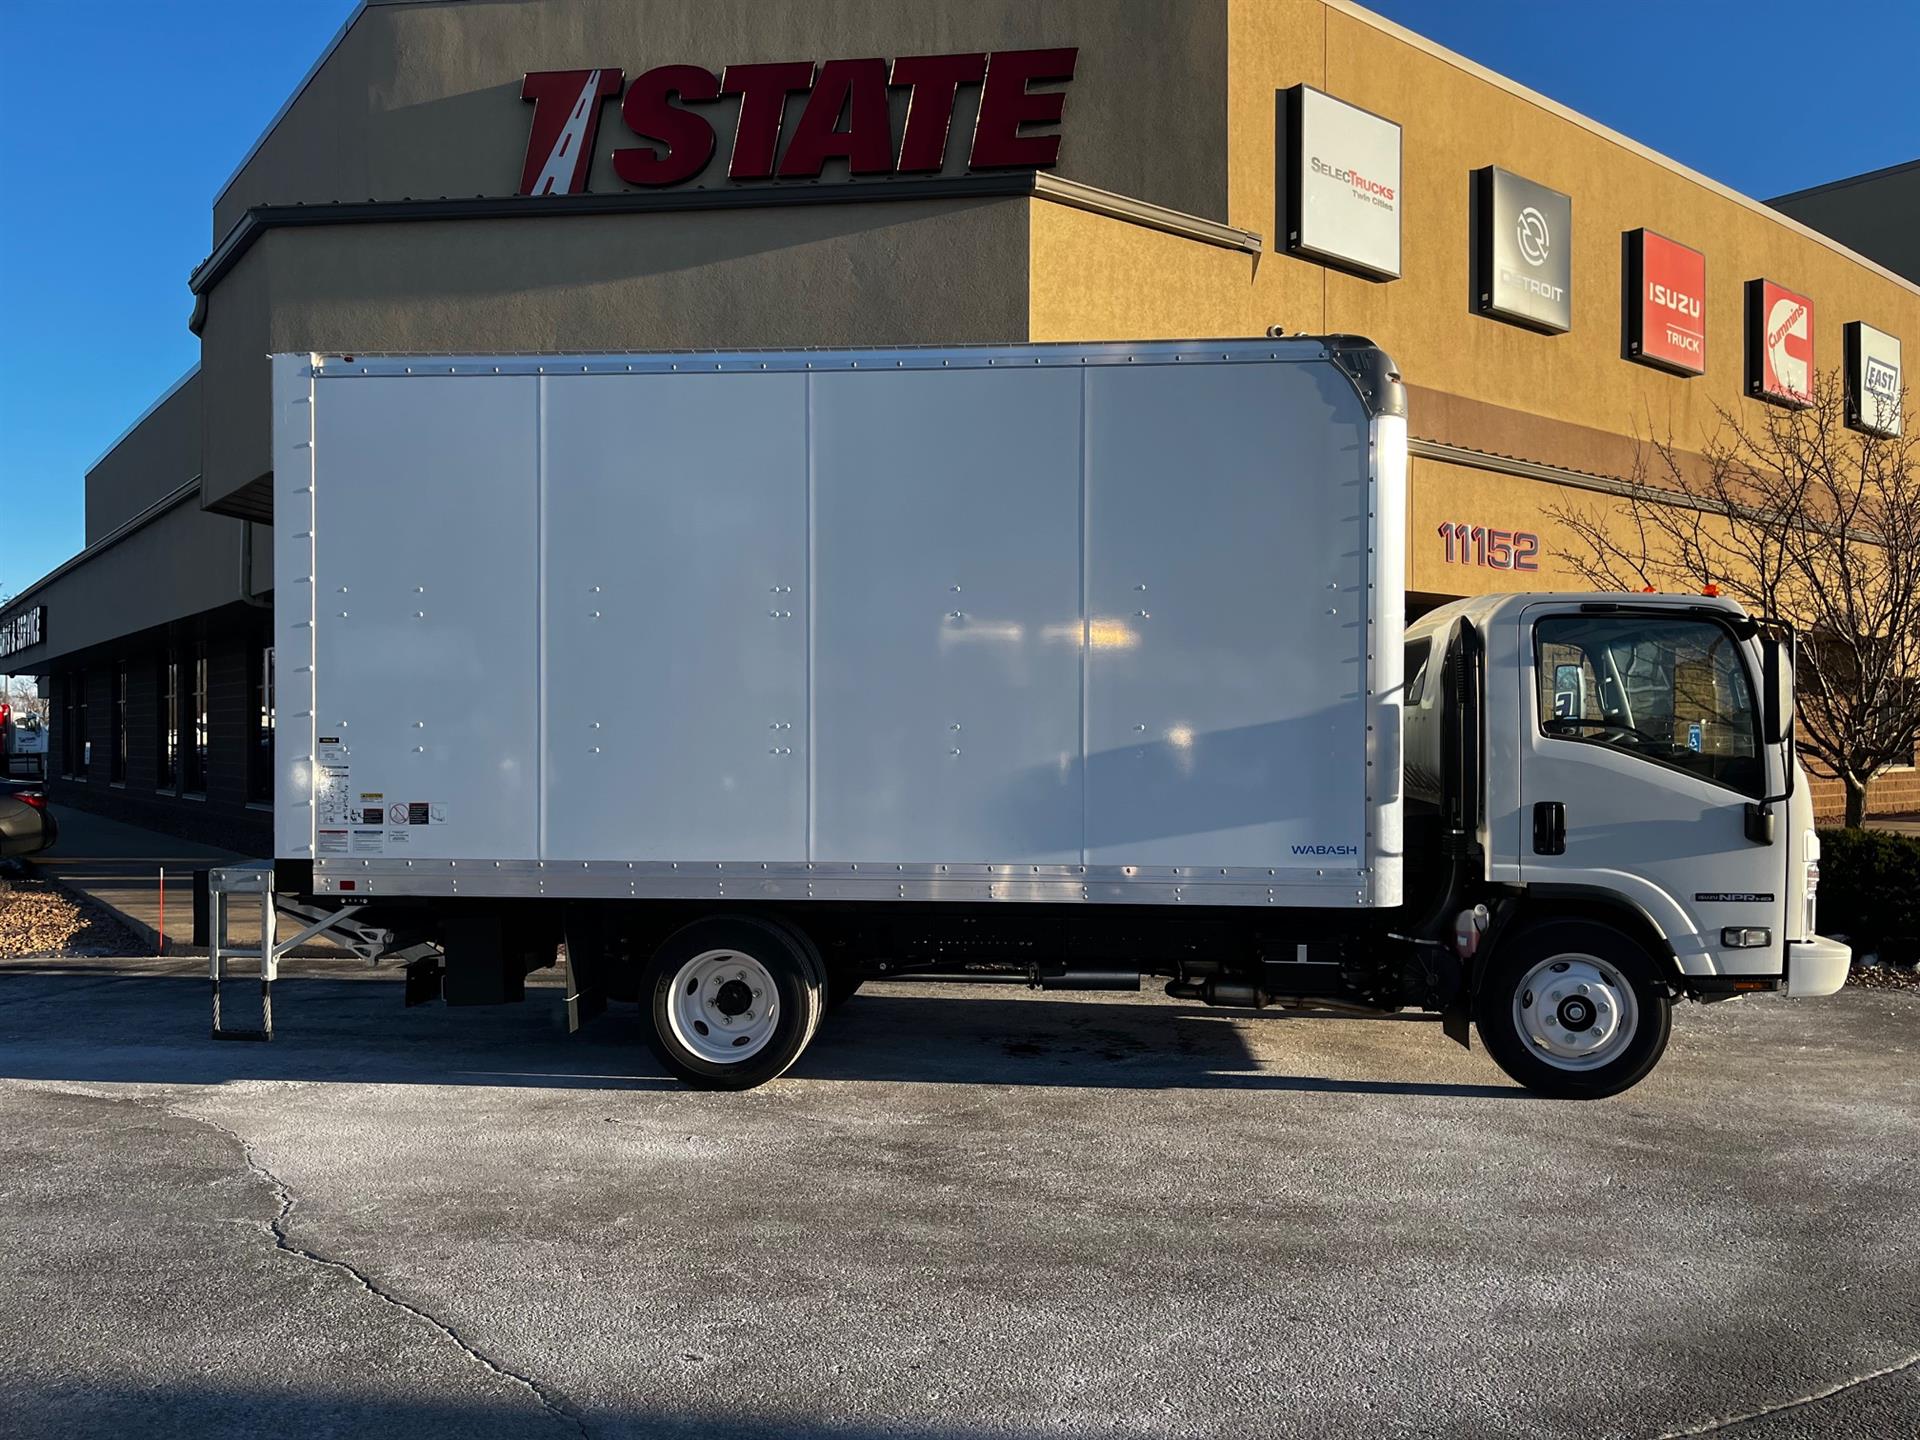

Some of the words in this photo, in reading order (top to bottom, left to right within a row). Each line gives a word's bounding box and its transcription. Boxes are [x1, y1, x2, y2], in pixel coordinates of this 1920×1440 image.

[1352, 189, 1371, 203] Twin
[1372, 196, 1393, 212] Cities
[1501, 270, 1564, 302] DETROIT
[1649, 282, 1700, 318] ISUZU
[1666, 329, 1700, 353] TRUCK
[1768, 305, 1804, 349] Cummins
[1869, 366, 1894, 392] EAST
[1438, 521, 1539, 572] 11152
[1291, 845, 1357, 855] WABASH
